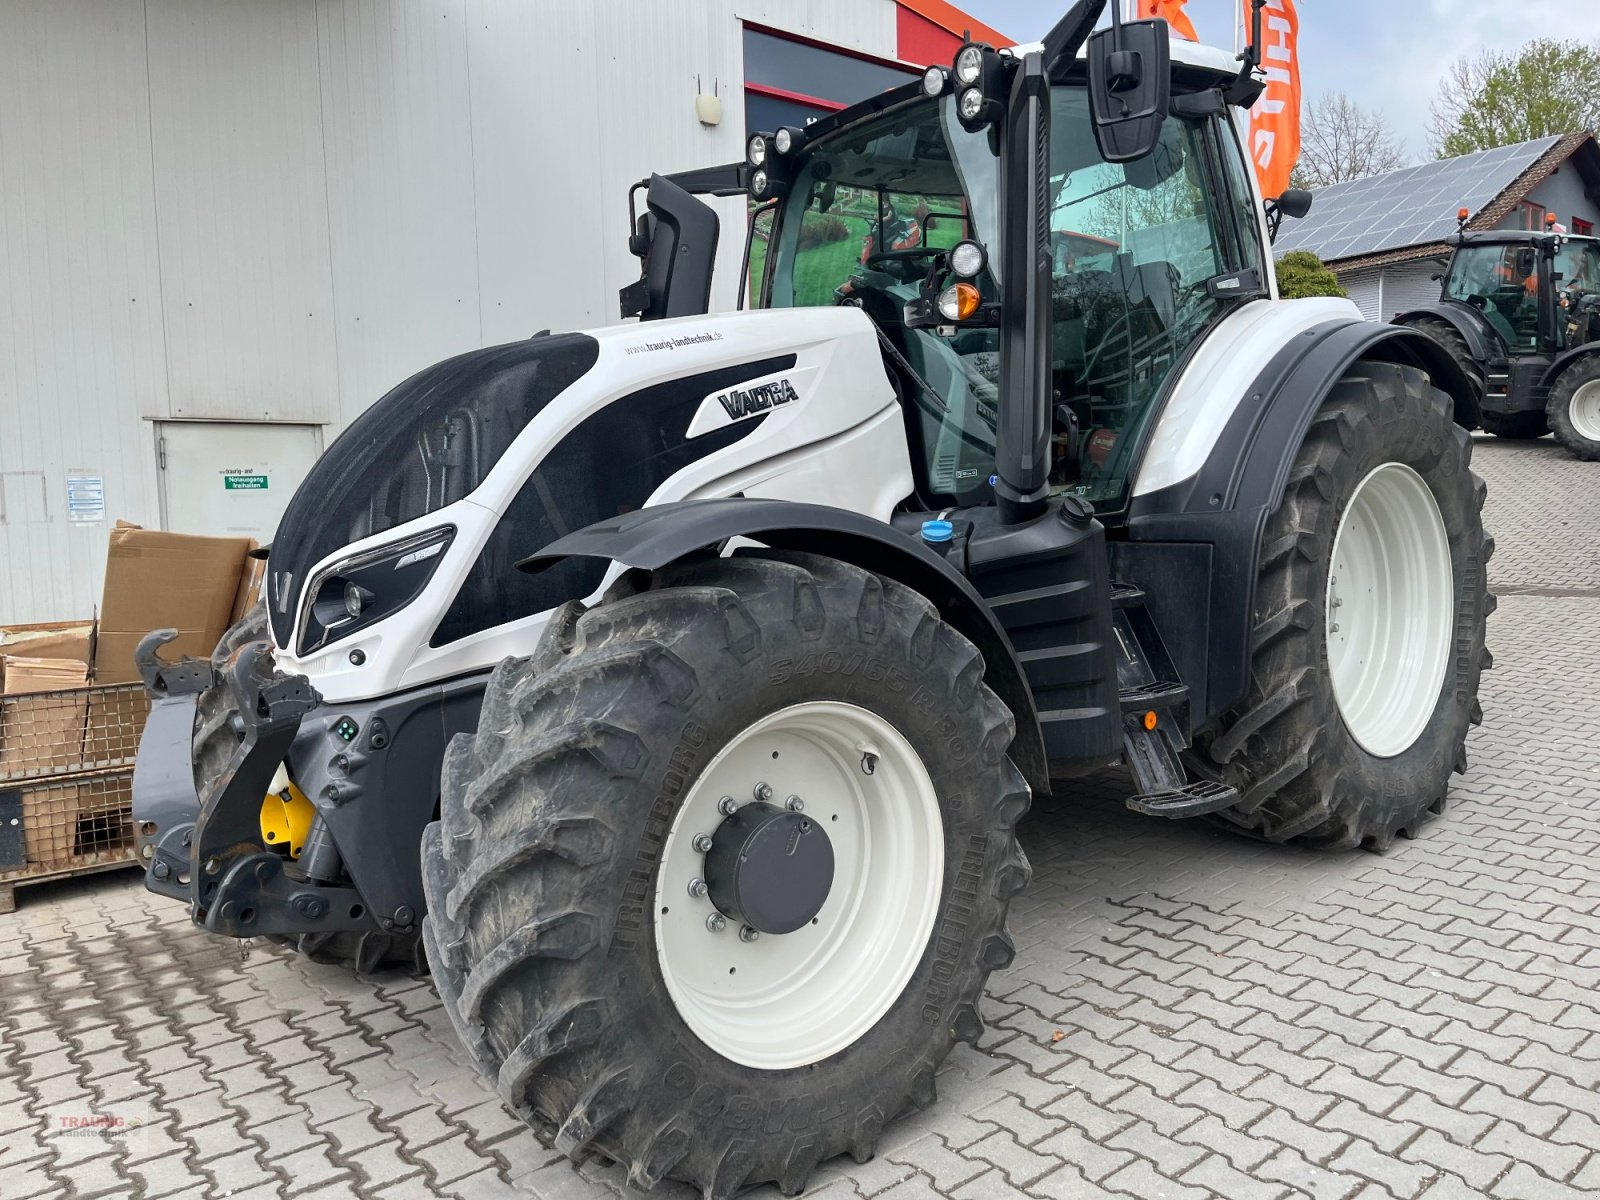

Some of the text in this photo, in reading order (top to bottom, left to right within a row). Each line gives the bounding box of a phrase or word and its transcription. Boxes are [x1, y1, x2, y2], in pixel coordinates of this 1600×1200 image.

[1251, 0, 1291, 170] STIH
[624, 331, 724, 355] www.traurig-landtechnik.de
[718, 379, 799, 420] VALTRA
[607, 720, 706, 957] TRELLEBORG
[920, 831, 990, 1026] TRELLEBORG
